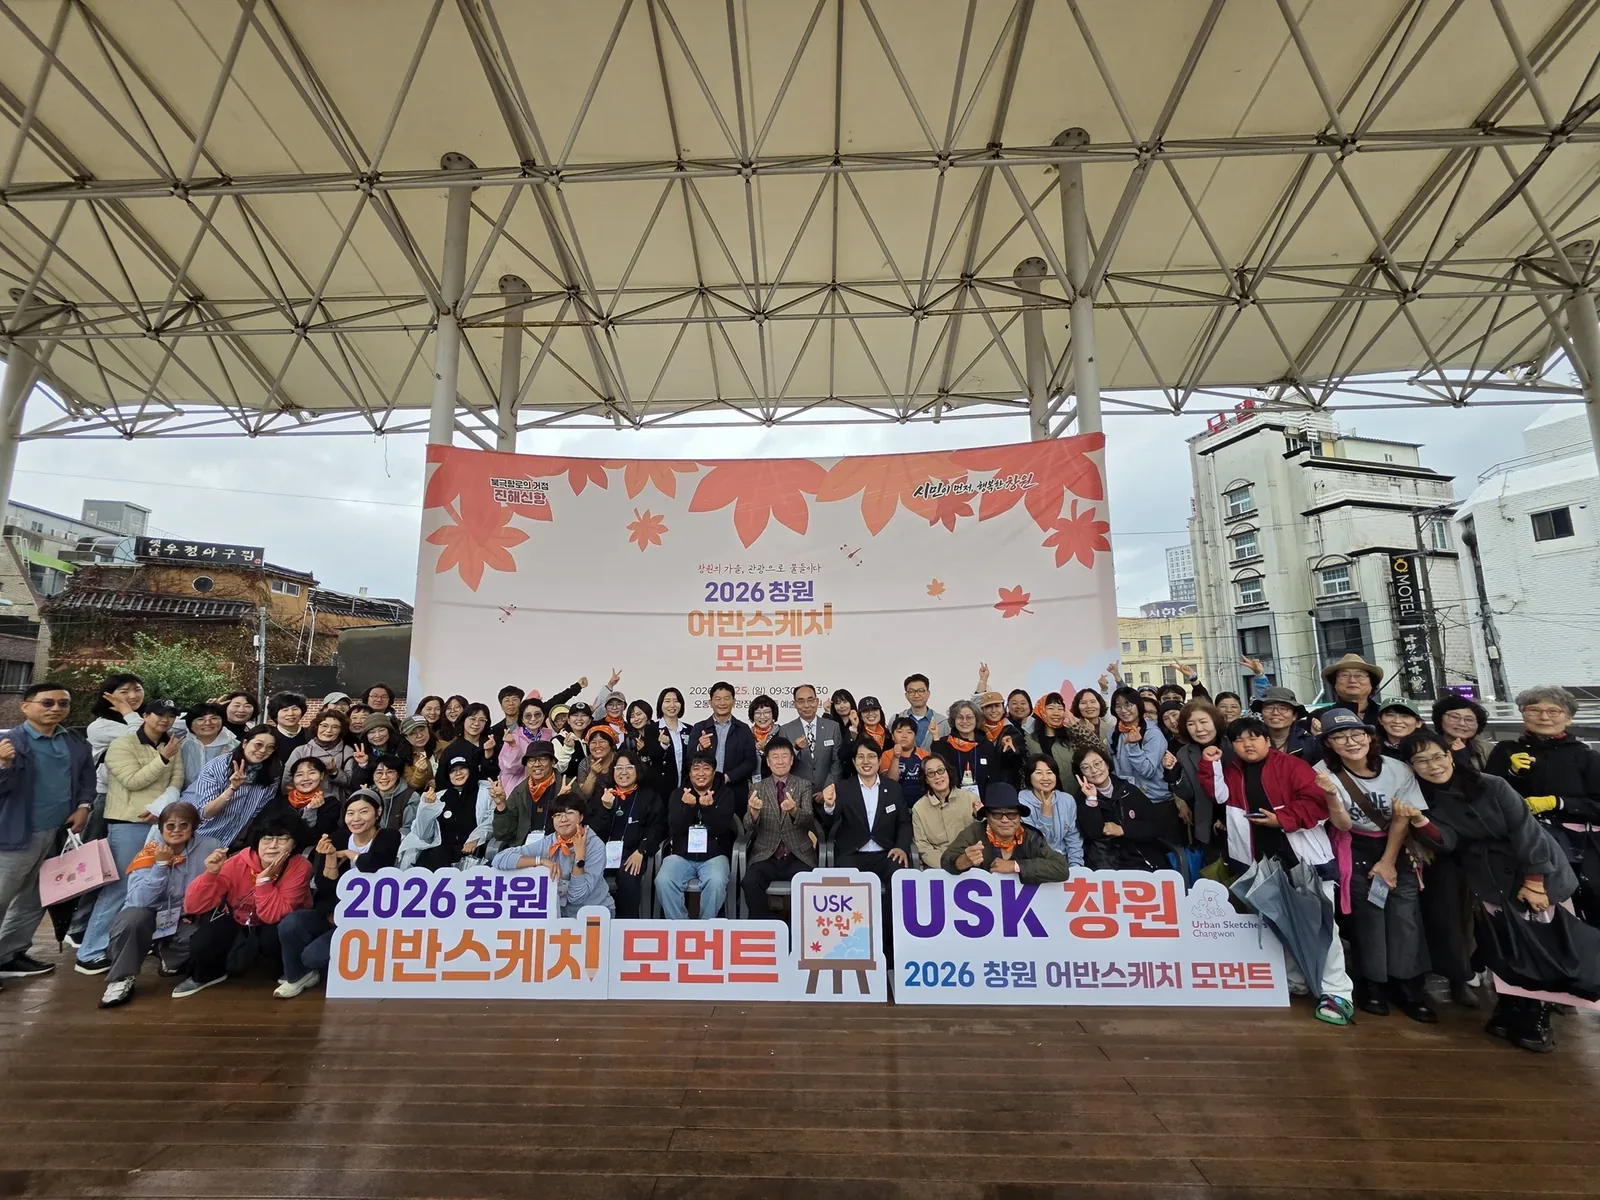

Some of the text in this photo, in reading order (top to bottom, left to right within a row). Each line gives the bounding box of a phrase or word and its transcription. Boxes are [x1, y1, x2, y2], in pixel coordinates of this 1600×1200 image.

[494, 489, 547, 505] 진해신항
[533, 481, 549, 490] 거점
[913, 473, 1038, 499] 시민이 먼저, 행복한 창원
[704, 580, 814, 603] 2026 창원
[1395, 574, 1415, 617] MOTEL
[688, 602, 833, 637] 어반스케치
[716, 644, 803, 672] 모먼트
[344, 876, 549, 920] 2026 창원
[813, 894, 854, 913] USK
[902, 877, 1180, 939] USK 창원
[816, 914, 850, 937] 창원
[1191, 920, 1268, 929] Urban Sketches
[1192, 929, 1235, 940] Changwon
[338, 915, 779, 983] 어반스케치 모먼트
[904, 960, 1275, 989] 2026 창원 어반스케치 모먼트
